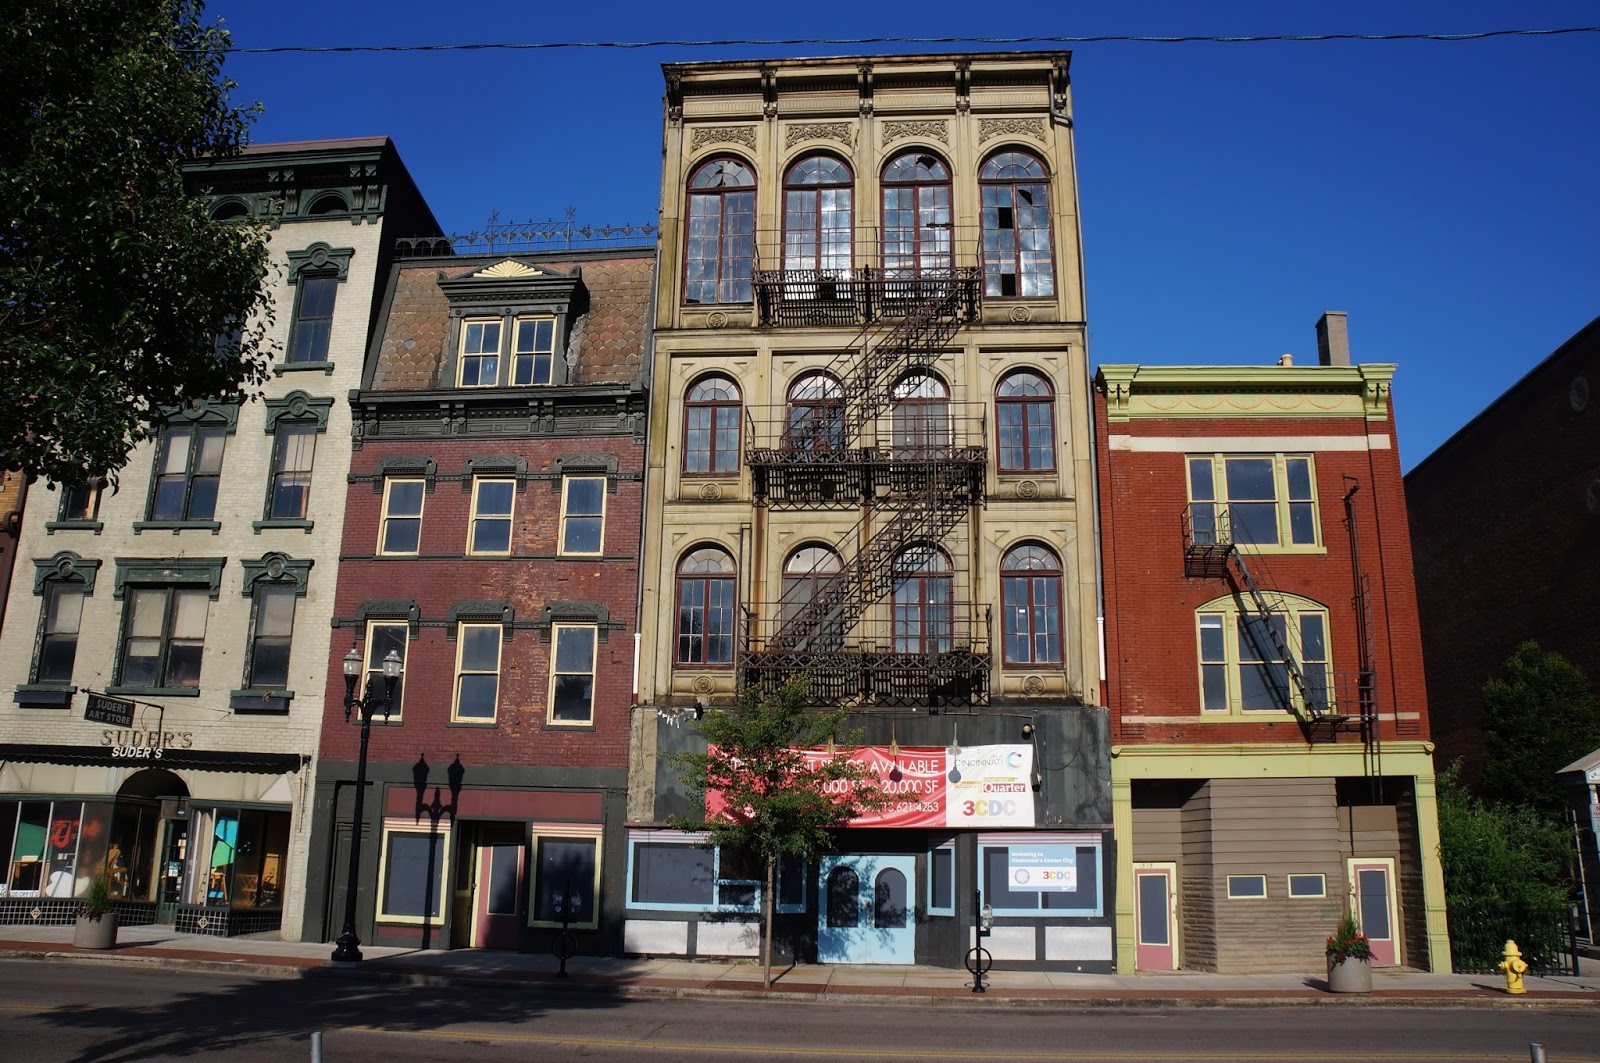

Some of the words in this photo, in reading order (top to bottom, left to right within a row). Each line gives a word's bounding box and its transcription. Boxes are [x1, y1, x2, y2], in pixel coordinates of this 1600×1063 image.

[96, 699, 127, 713] SUDERS
[88, 709, 104, 720] ART
[106, 713, 131, 724] STORE
[101, 729, 193, 748] SUDER'S
[111, 746, 163, 758] SUDER'S
[924, 779, 939, 794] SF
[984, 783, 1026, 793] Quarter
[962, 800, 1017, 817] 3CDC
[1043, 871, 1071, 880] 3CDC
